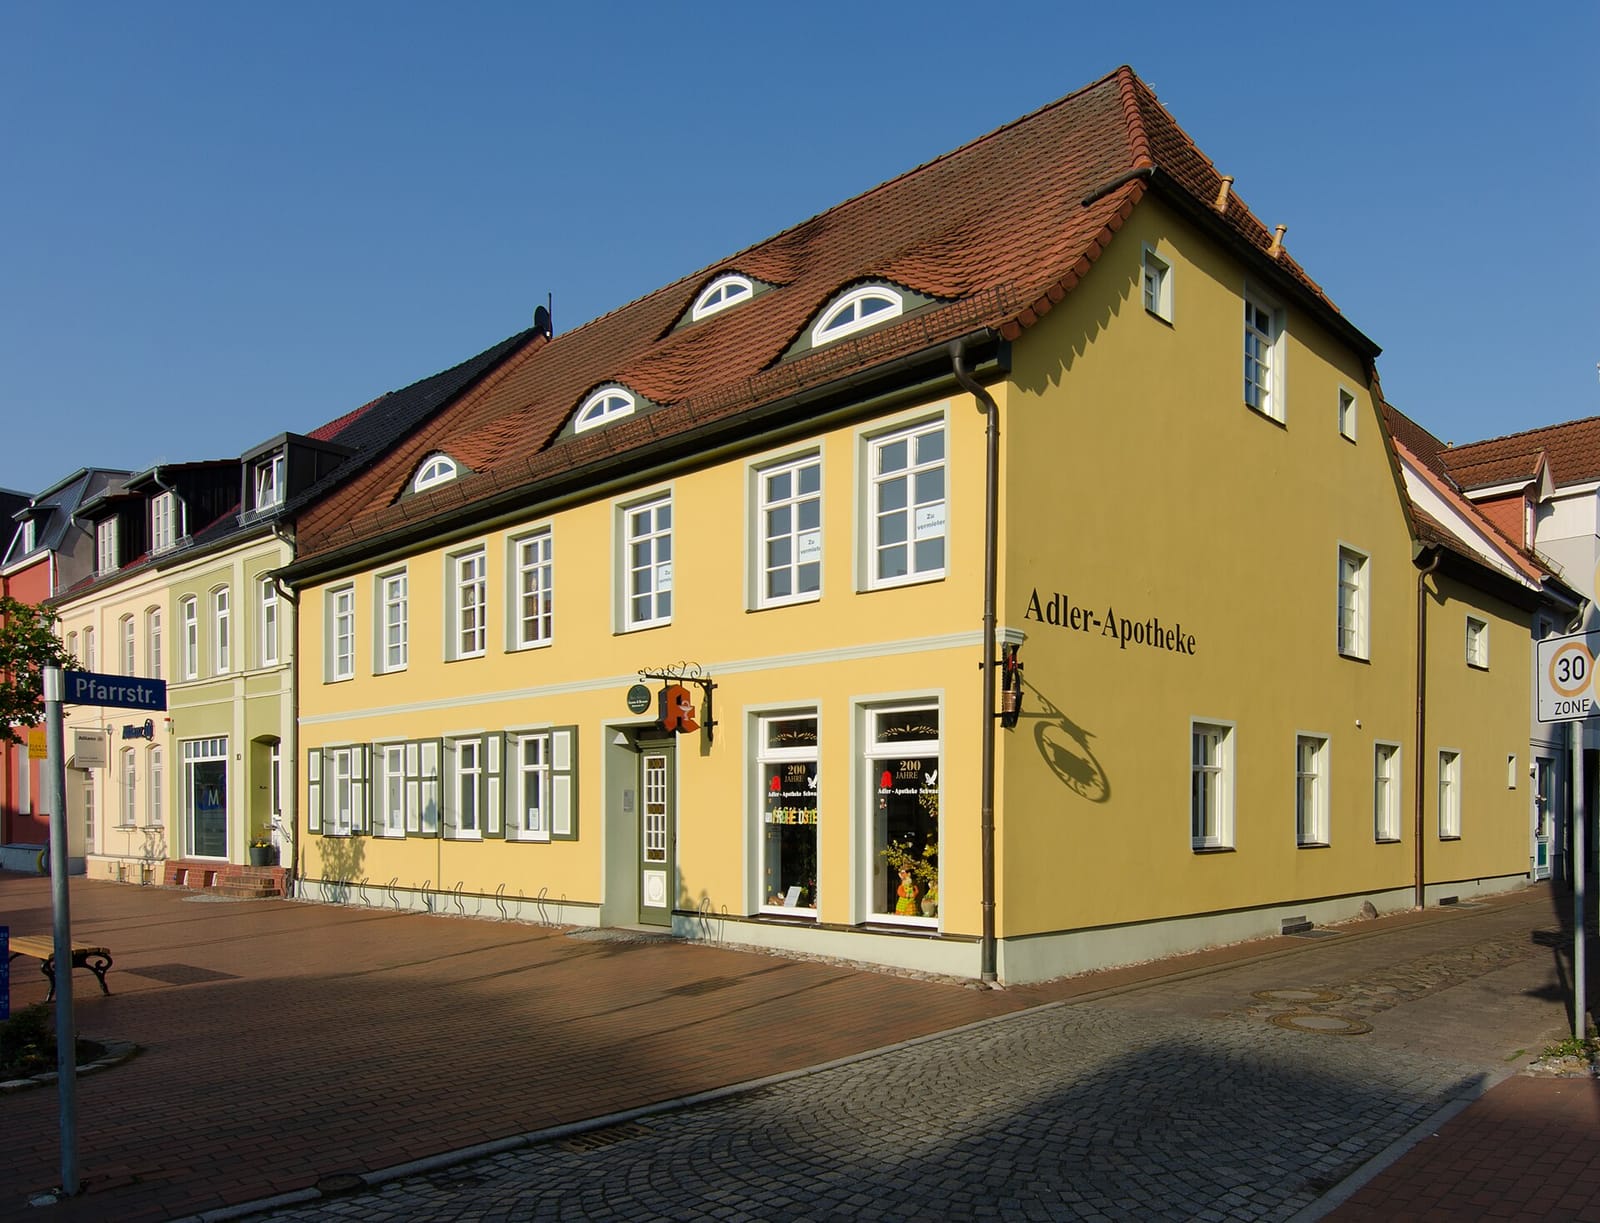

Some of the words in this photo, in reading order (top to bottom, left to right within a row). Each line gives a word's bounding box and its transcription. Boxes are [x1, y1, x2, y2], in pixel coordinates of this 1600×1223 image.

[1023, 587, 1197, 656] Adler-Apotheke
[1558, 655, 1585, 682] 30
[75, 677, 157, 704] Pfarrstr.
[1554, 698, 1591, 715] ZONE
[787, 764, 806, 775] 200
[899, 760, 921, 771] 200
[895, 771, 919, 780] JAHRE
